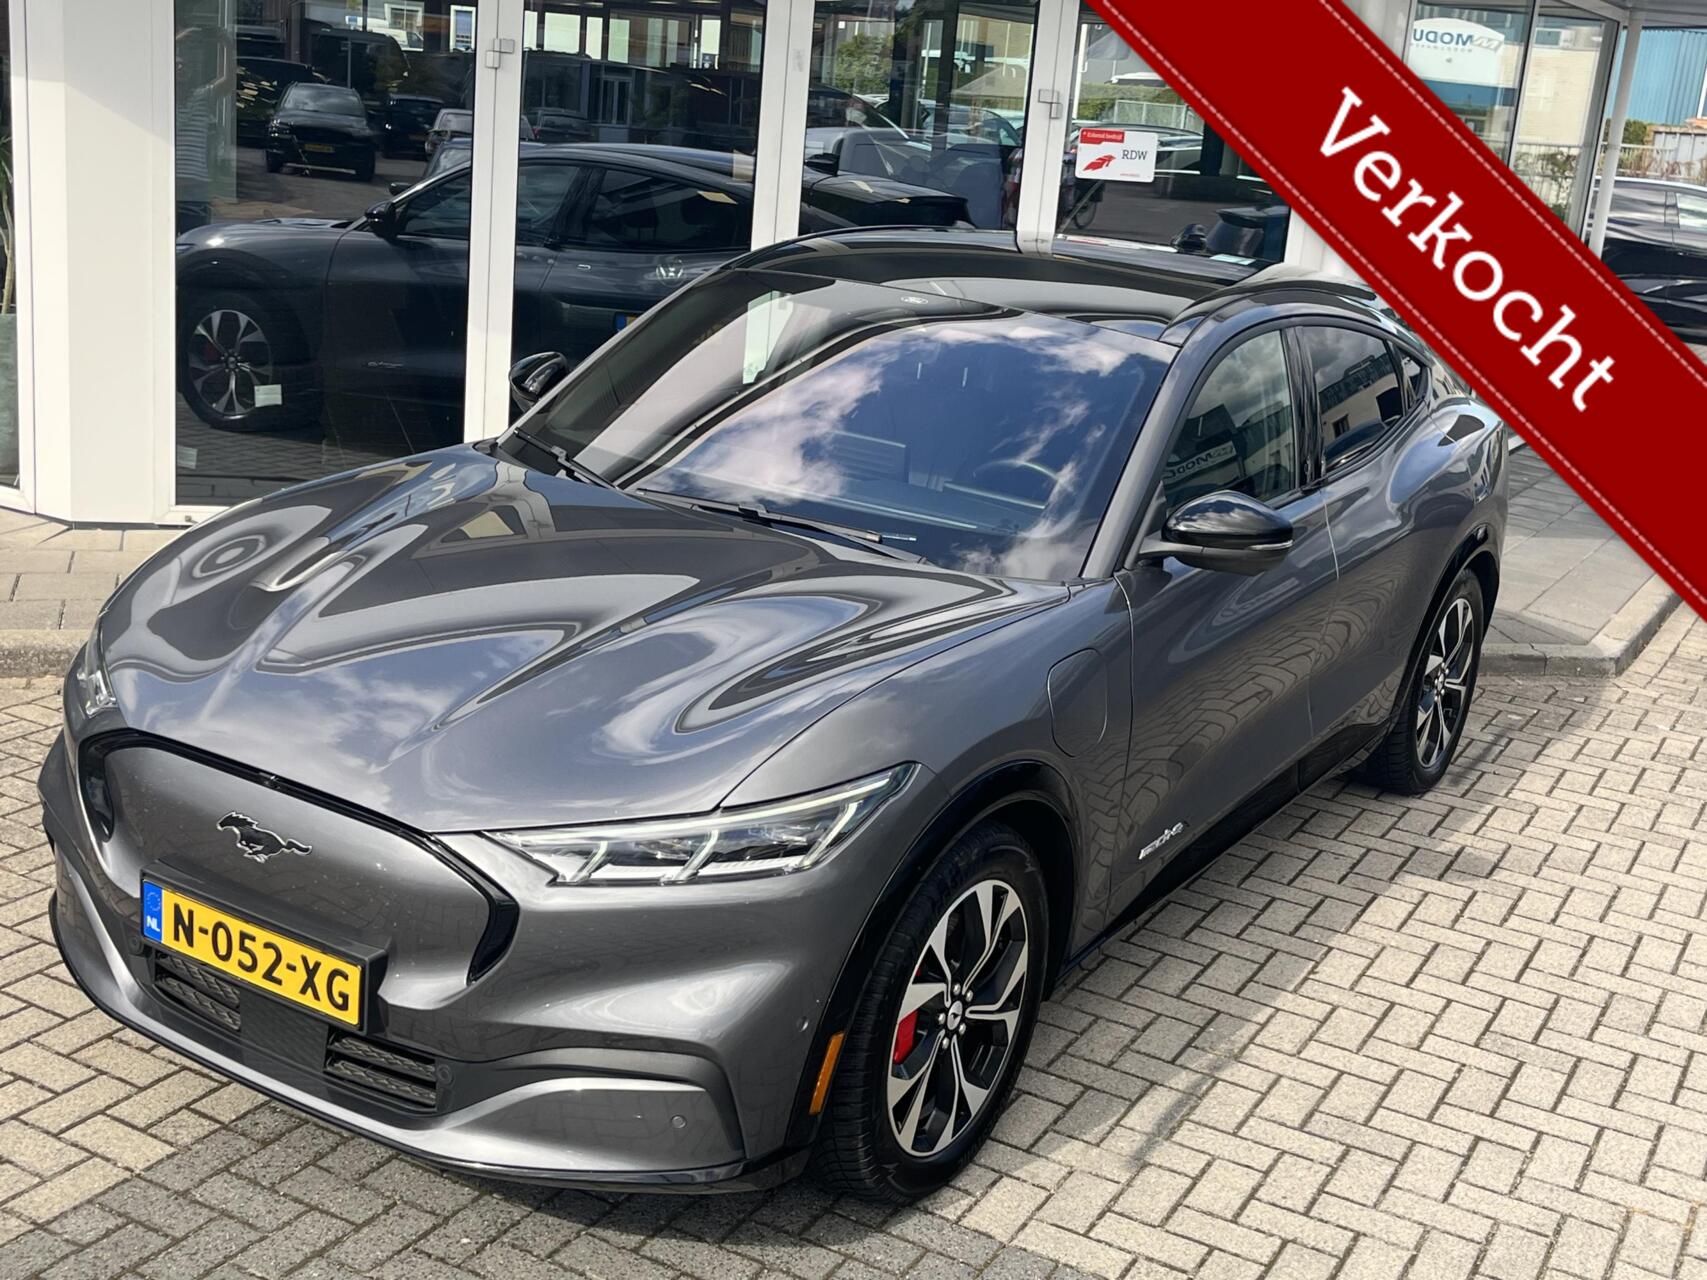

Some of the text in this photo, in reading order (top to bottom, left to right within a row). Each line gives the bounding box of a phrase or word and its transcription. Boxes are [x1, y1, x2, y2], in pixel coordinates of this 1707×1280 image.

[1122, 149, 1148, 161] RDW
[146, 914, 161, 932] NL
[173, 902, 349, 1012] N-052-XG
